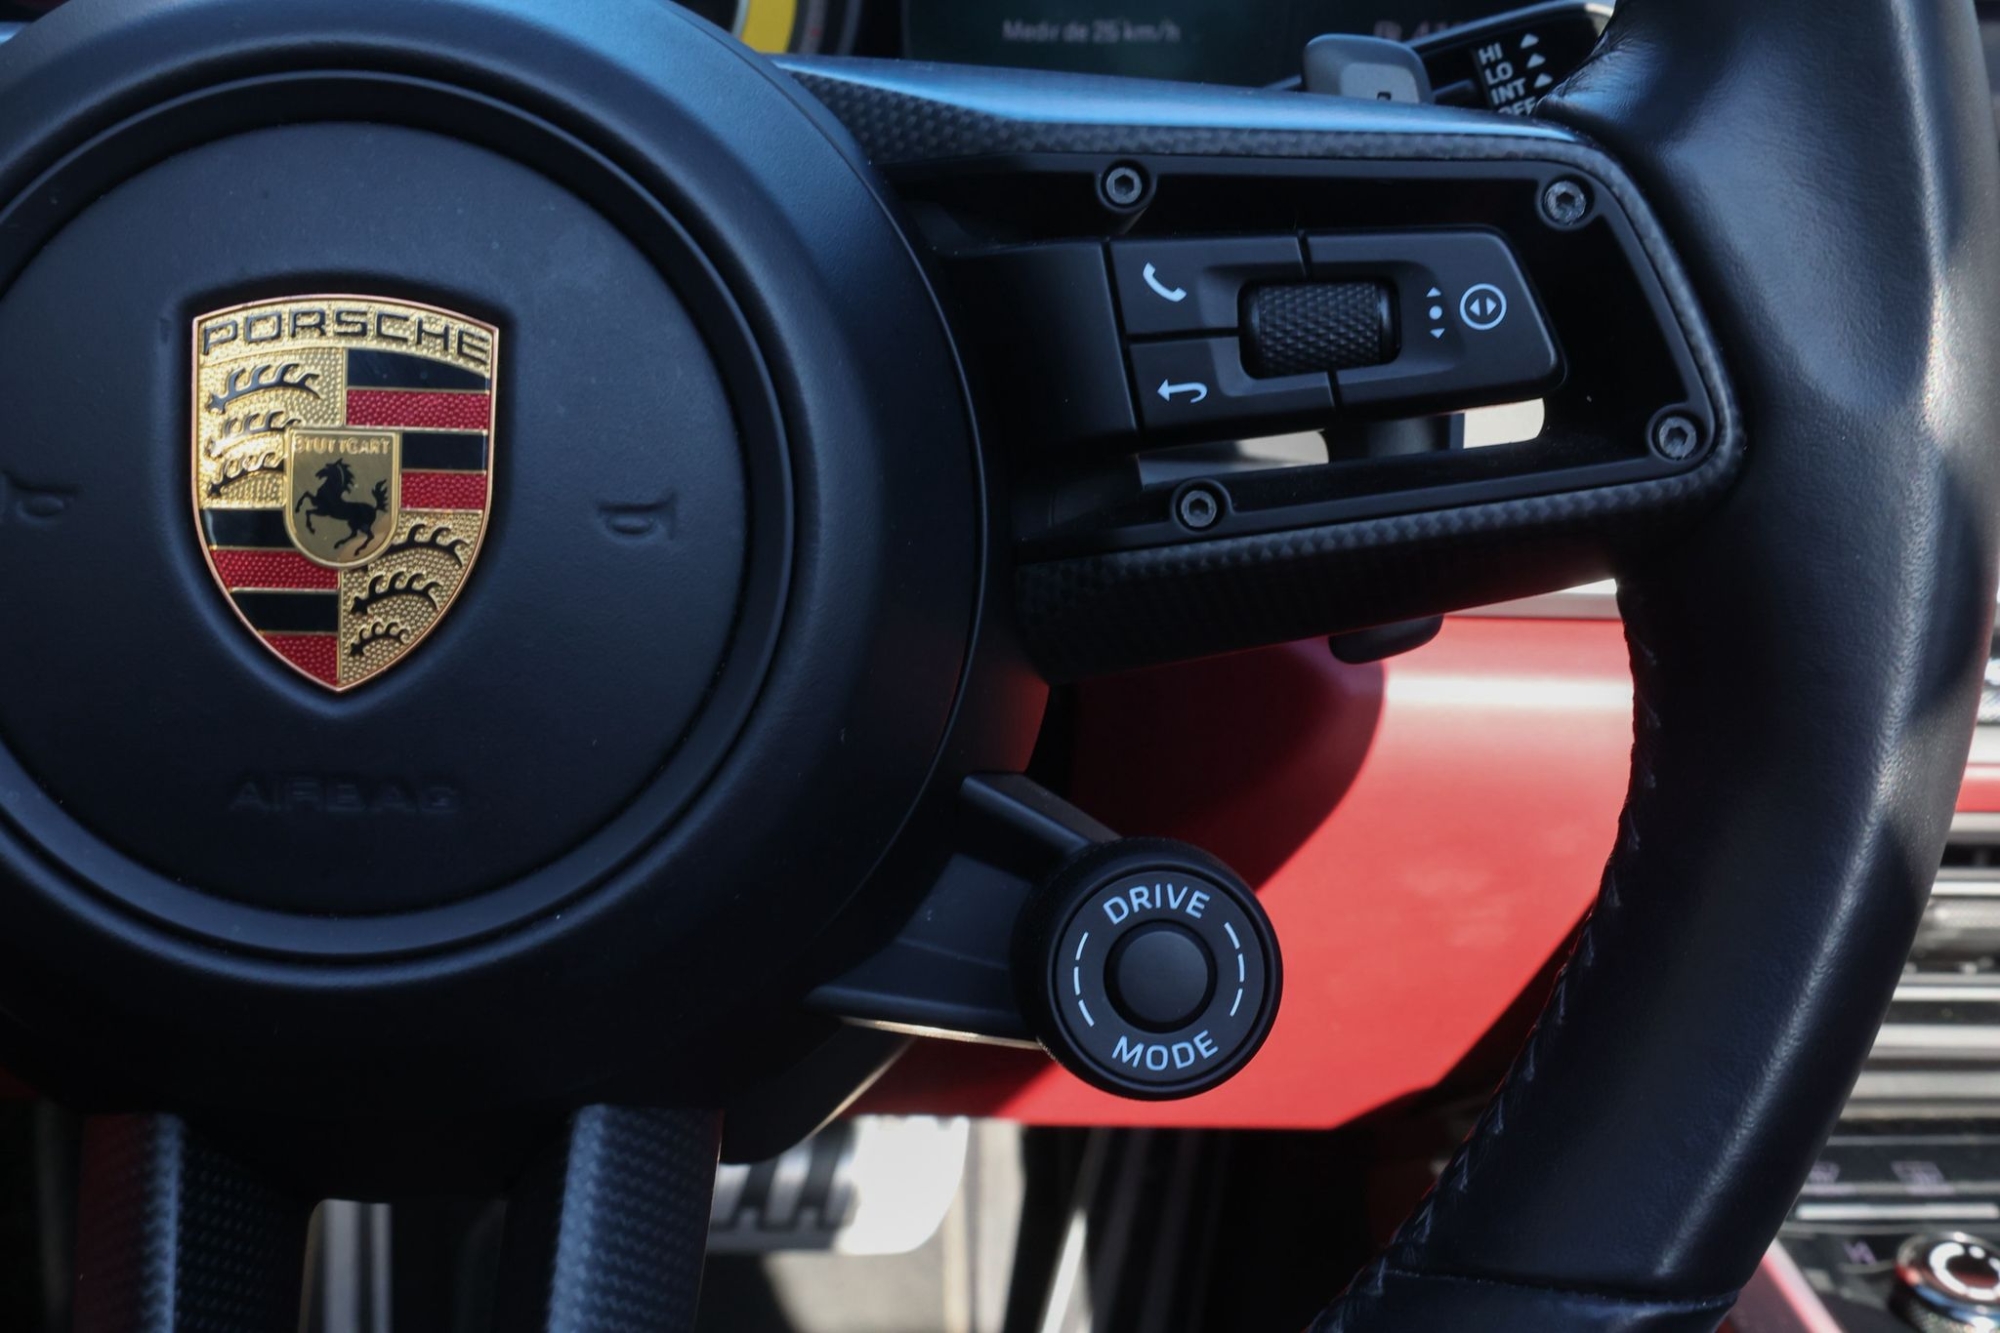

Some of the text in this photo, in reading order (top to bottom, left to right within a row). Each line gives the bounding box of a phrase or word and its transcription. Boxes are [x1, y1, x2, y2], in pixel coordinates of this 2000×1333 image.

[1062, 20, 1088, 42] de
[1121, 16, 1181, 42] km/h
[1478, 42, 1503, 65] HI
[1484, 61, 1514, 86] LO
[1491, 77, 1526, 105] INT
[202, 309, 491, 366] PORSCHE
[292, 435, 391, 455] STUTTGART
[228, 777, 460, 813] AIRBAG
[1102, 883, 1211, 925] DRIVE
[1111, 1030, 1219, 1071] MODE
